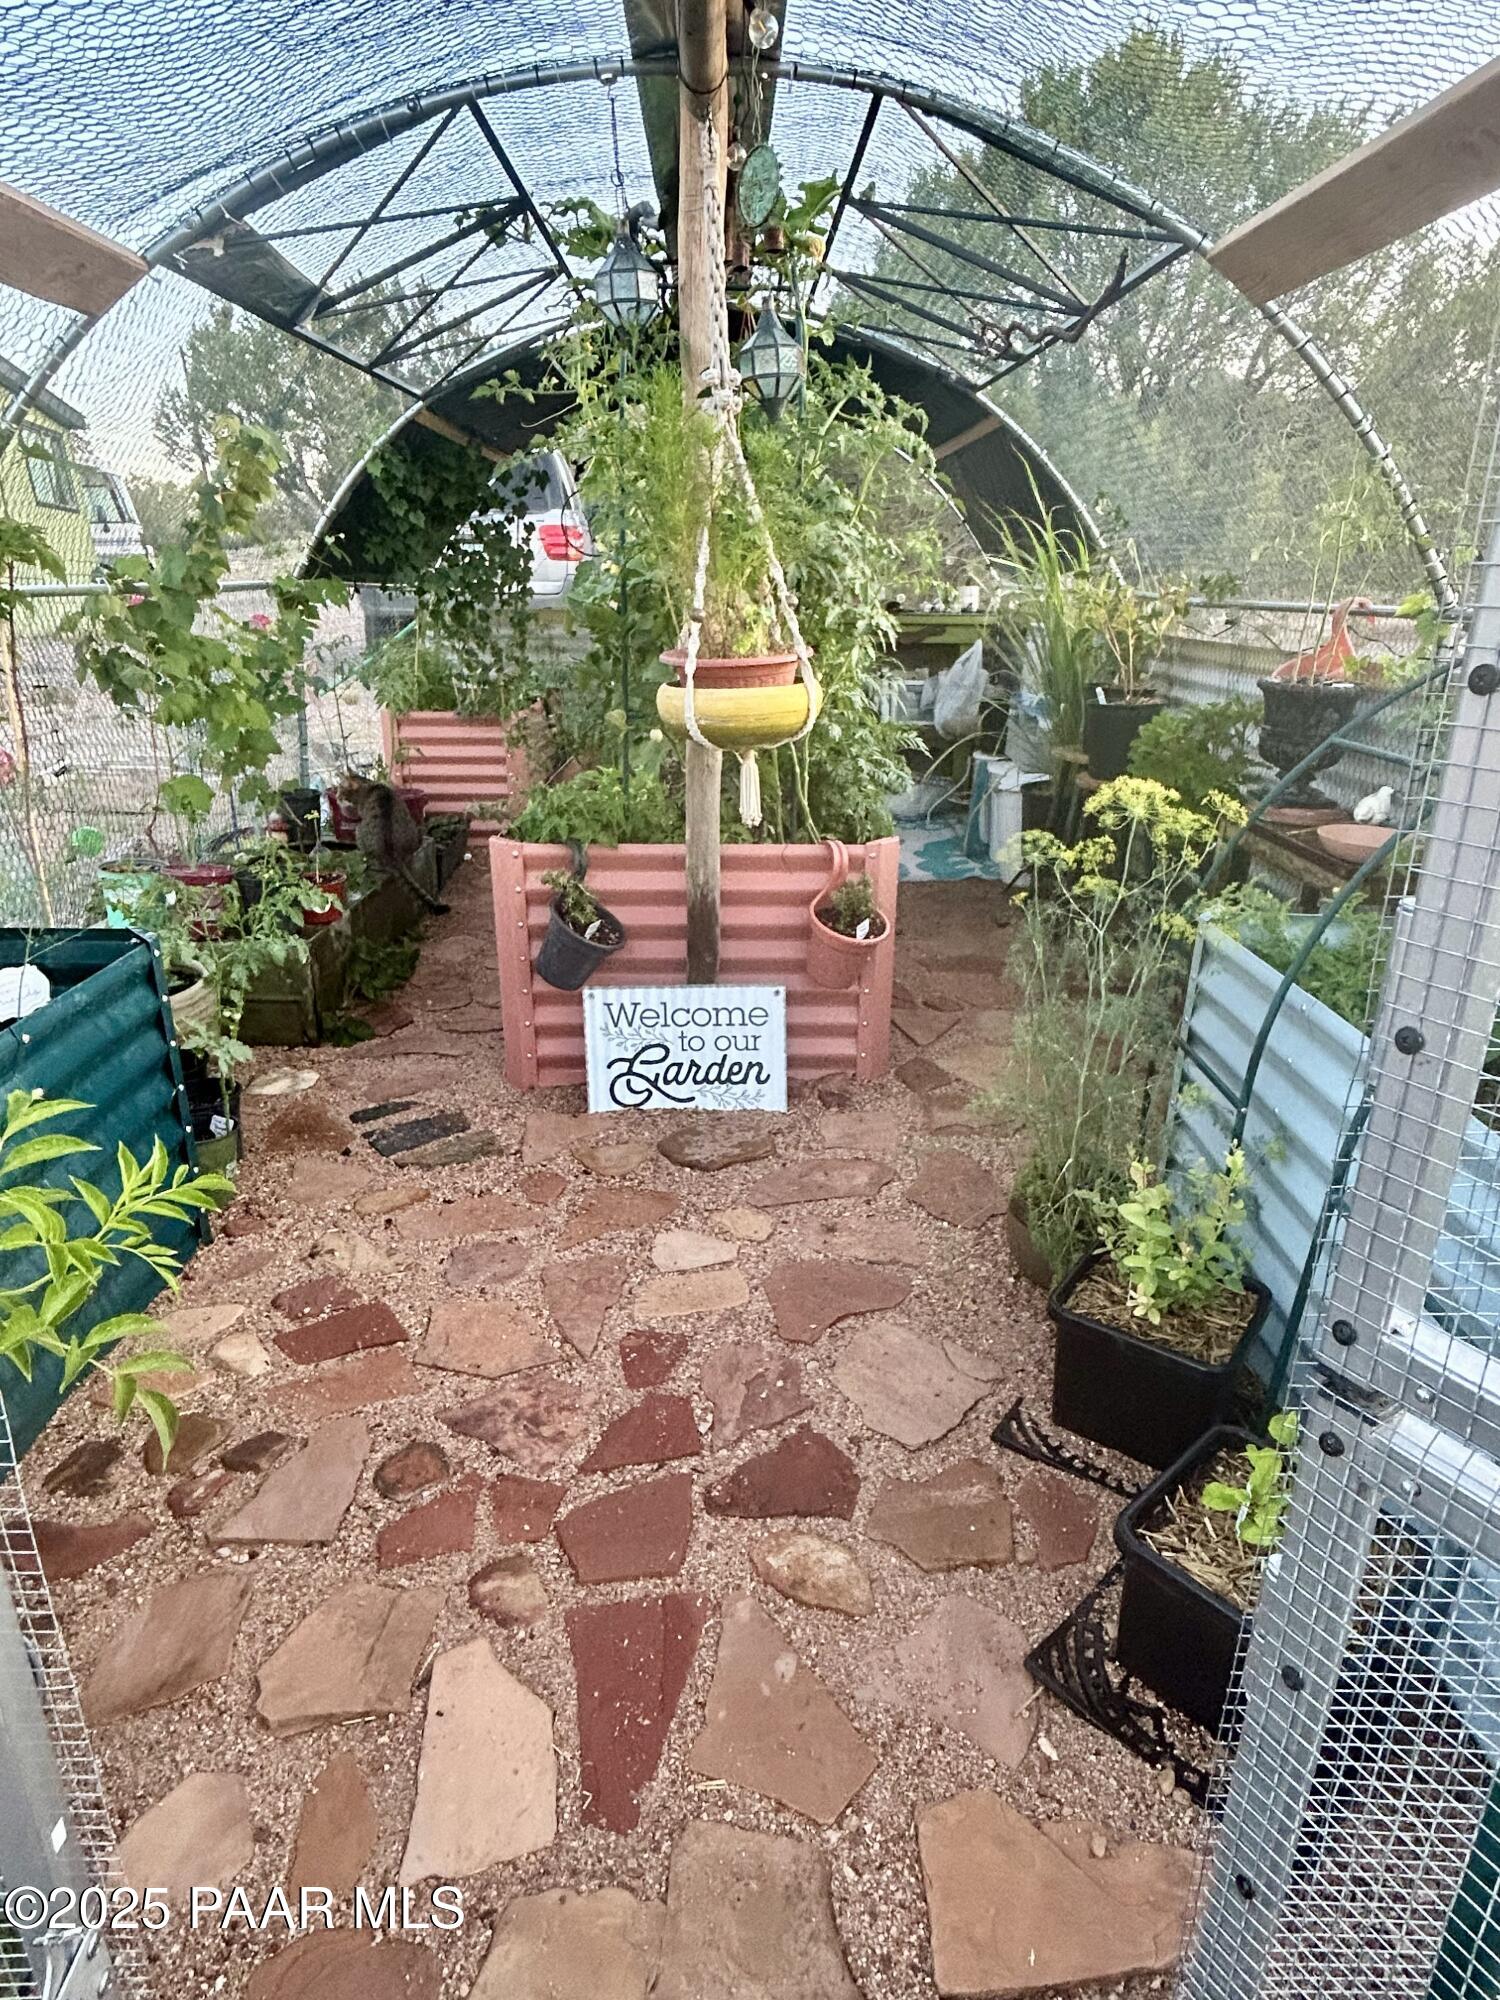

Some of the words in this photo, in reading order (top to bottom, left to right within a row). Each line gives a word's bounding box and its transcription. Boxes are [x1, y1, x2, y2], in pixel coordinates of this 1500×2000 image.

[603, 1002, 769, 1028] Welcome
[678, 1030, 705, 1052] to
[714, 1033, 762, 1052] our
[606, 1043, 771, 1107] Garden
